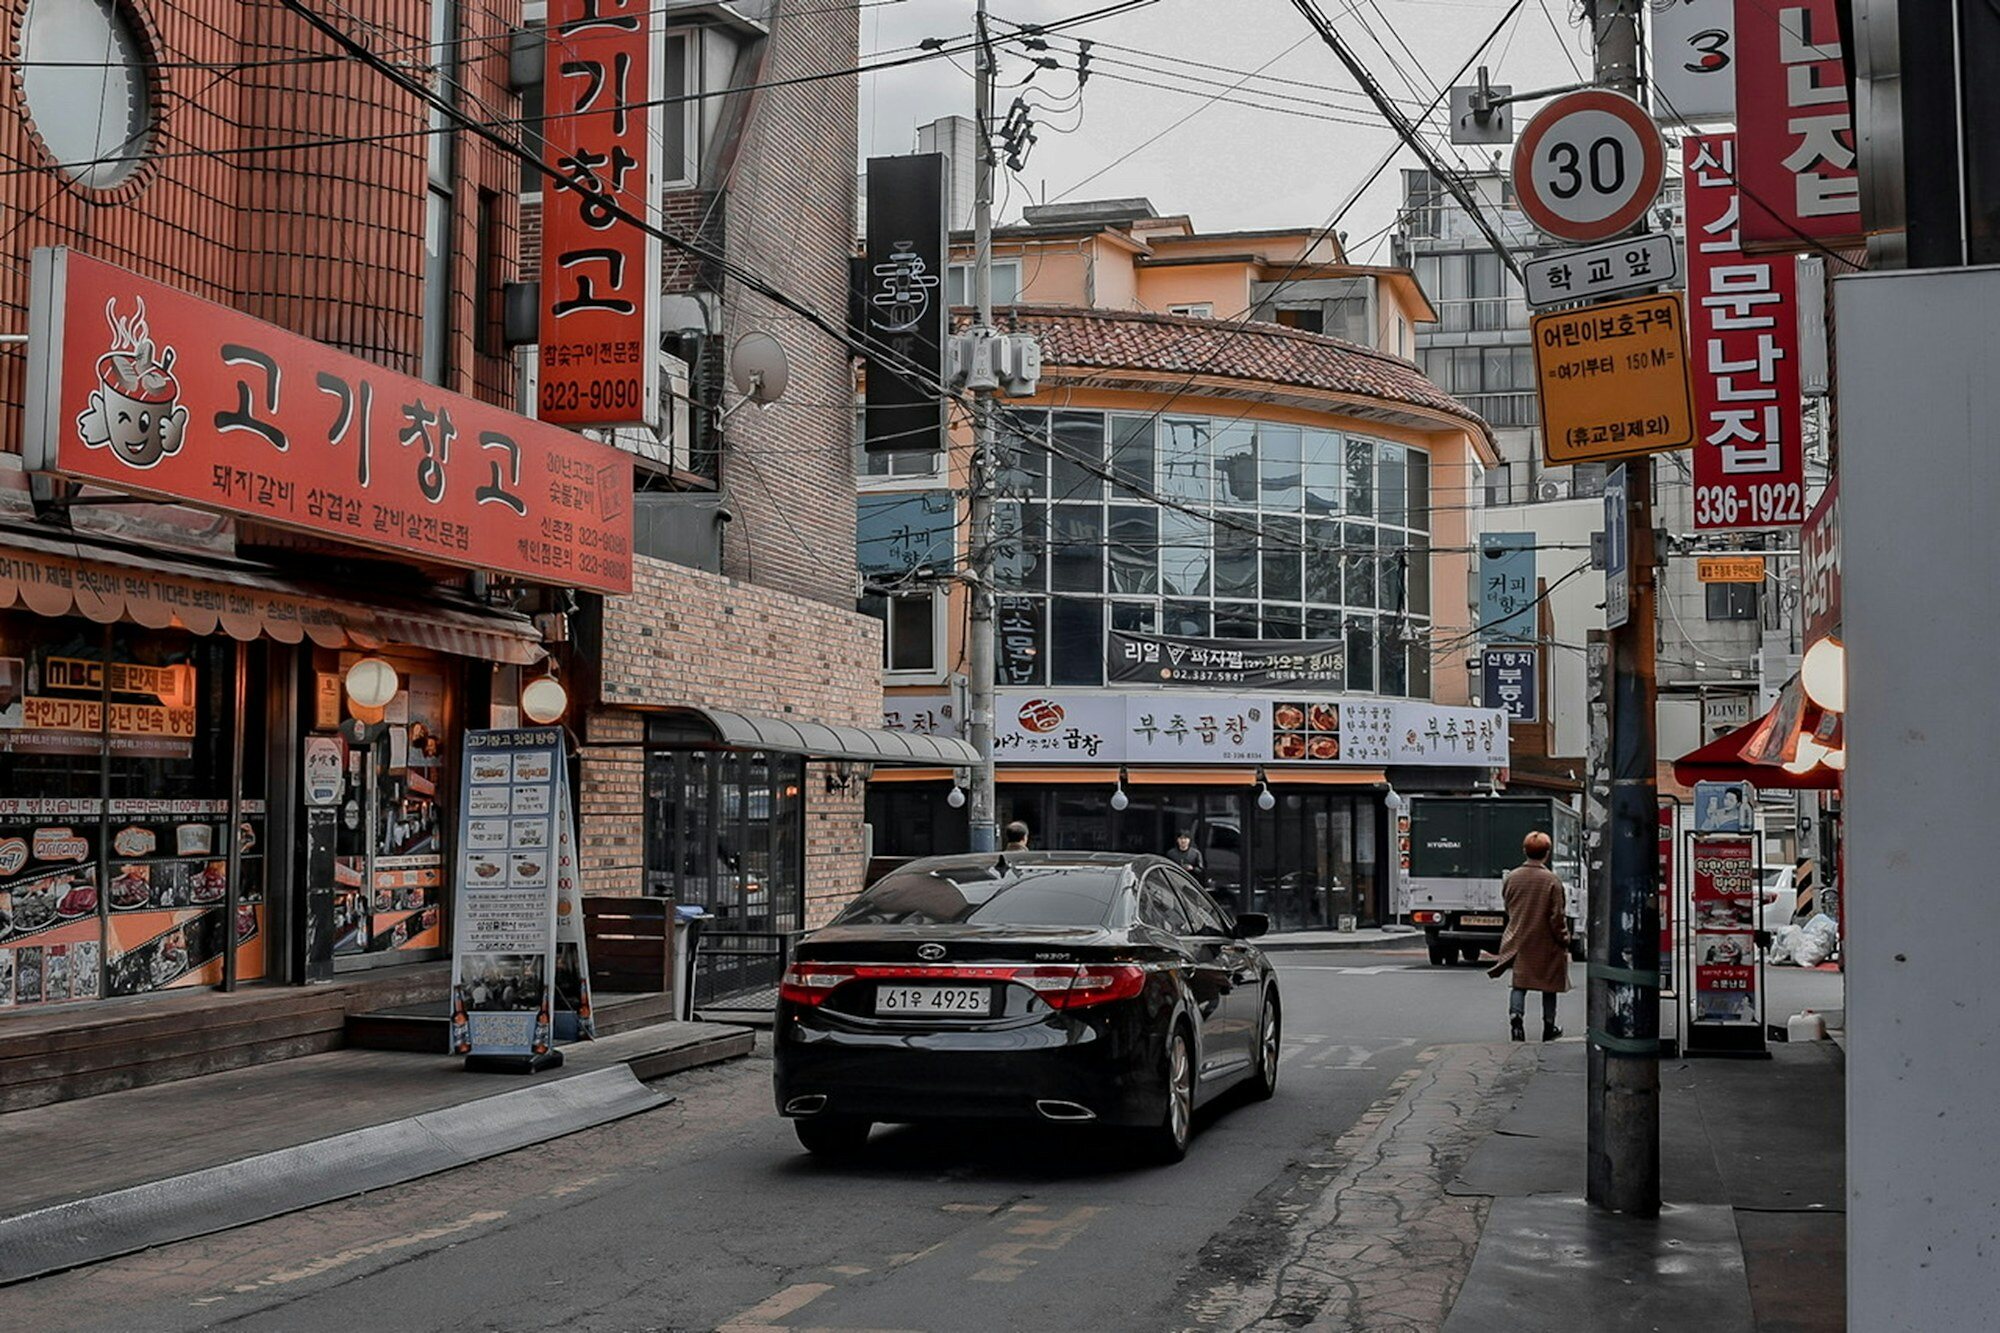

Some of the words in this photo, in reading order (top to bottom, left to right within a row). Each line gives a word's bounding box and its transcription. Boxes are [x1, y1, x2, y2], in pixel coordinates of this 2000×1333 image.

[1549, 136, 1625, 200] 30
[1543, 305, 1674, 349] 어린이보호구역
[543, 378, 639, 412] 323-9090
[213, 343, 528, 518] 고기창고
[1566, 414, 1671, 448] (휴교일제외)
[211, 464, 296, 513] 돼지갈비
[306, 487, 364, 528] 삼겹살
[372, 504, 471, 551] 갈비살전문점
[1696, 483, 1801, 524] 336-1922
[892, 525, 931, 551] 커피
[45, 565, 74, 589] 제일
[1487, 573, 1526, 594] 커피
[1125, 642, 1160, 664] 리얼
[1497, 668, 1525, 718] 부동산
[25, 701, 101, 730] 착한고기집
[137, 708, 163, 732] 연속
[168, 709, 194, 736] 방영
[1133, 713, 1251, 746] 부추곱창
[1424, 716, 1494, 754] 부추곱창
[1062, 728, 1103, 757] 곱창
[886, 989, 922, 1009] 61우
[931, 990, 980, 1010] 4925
